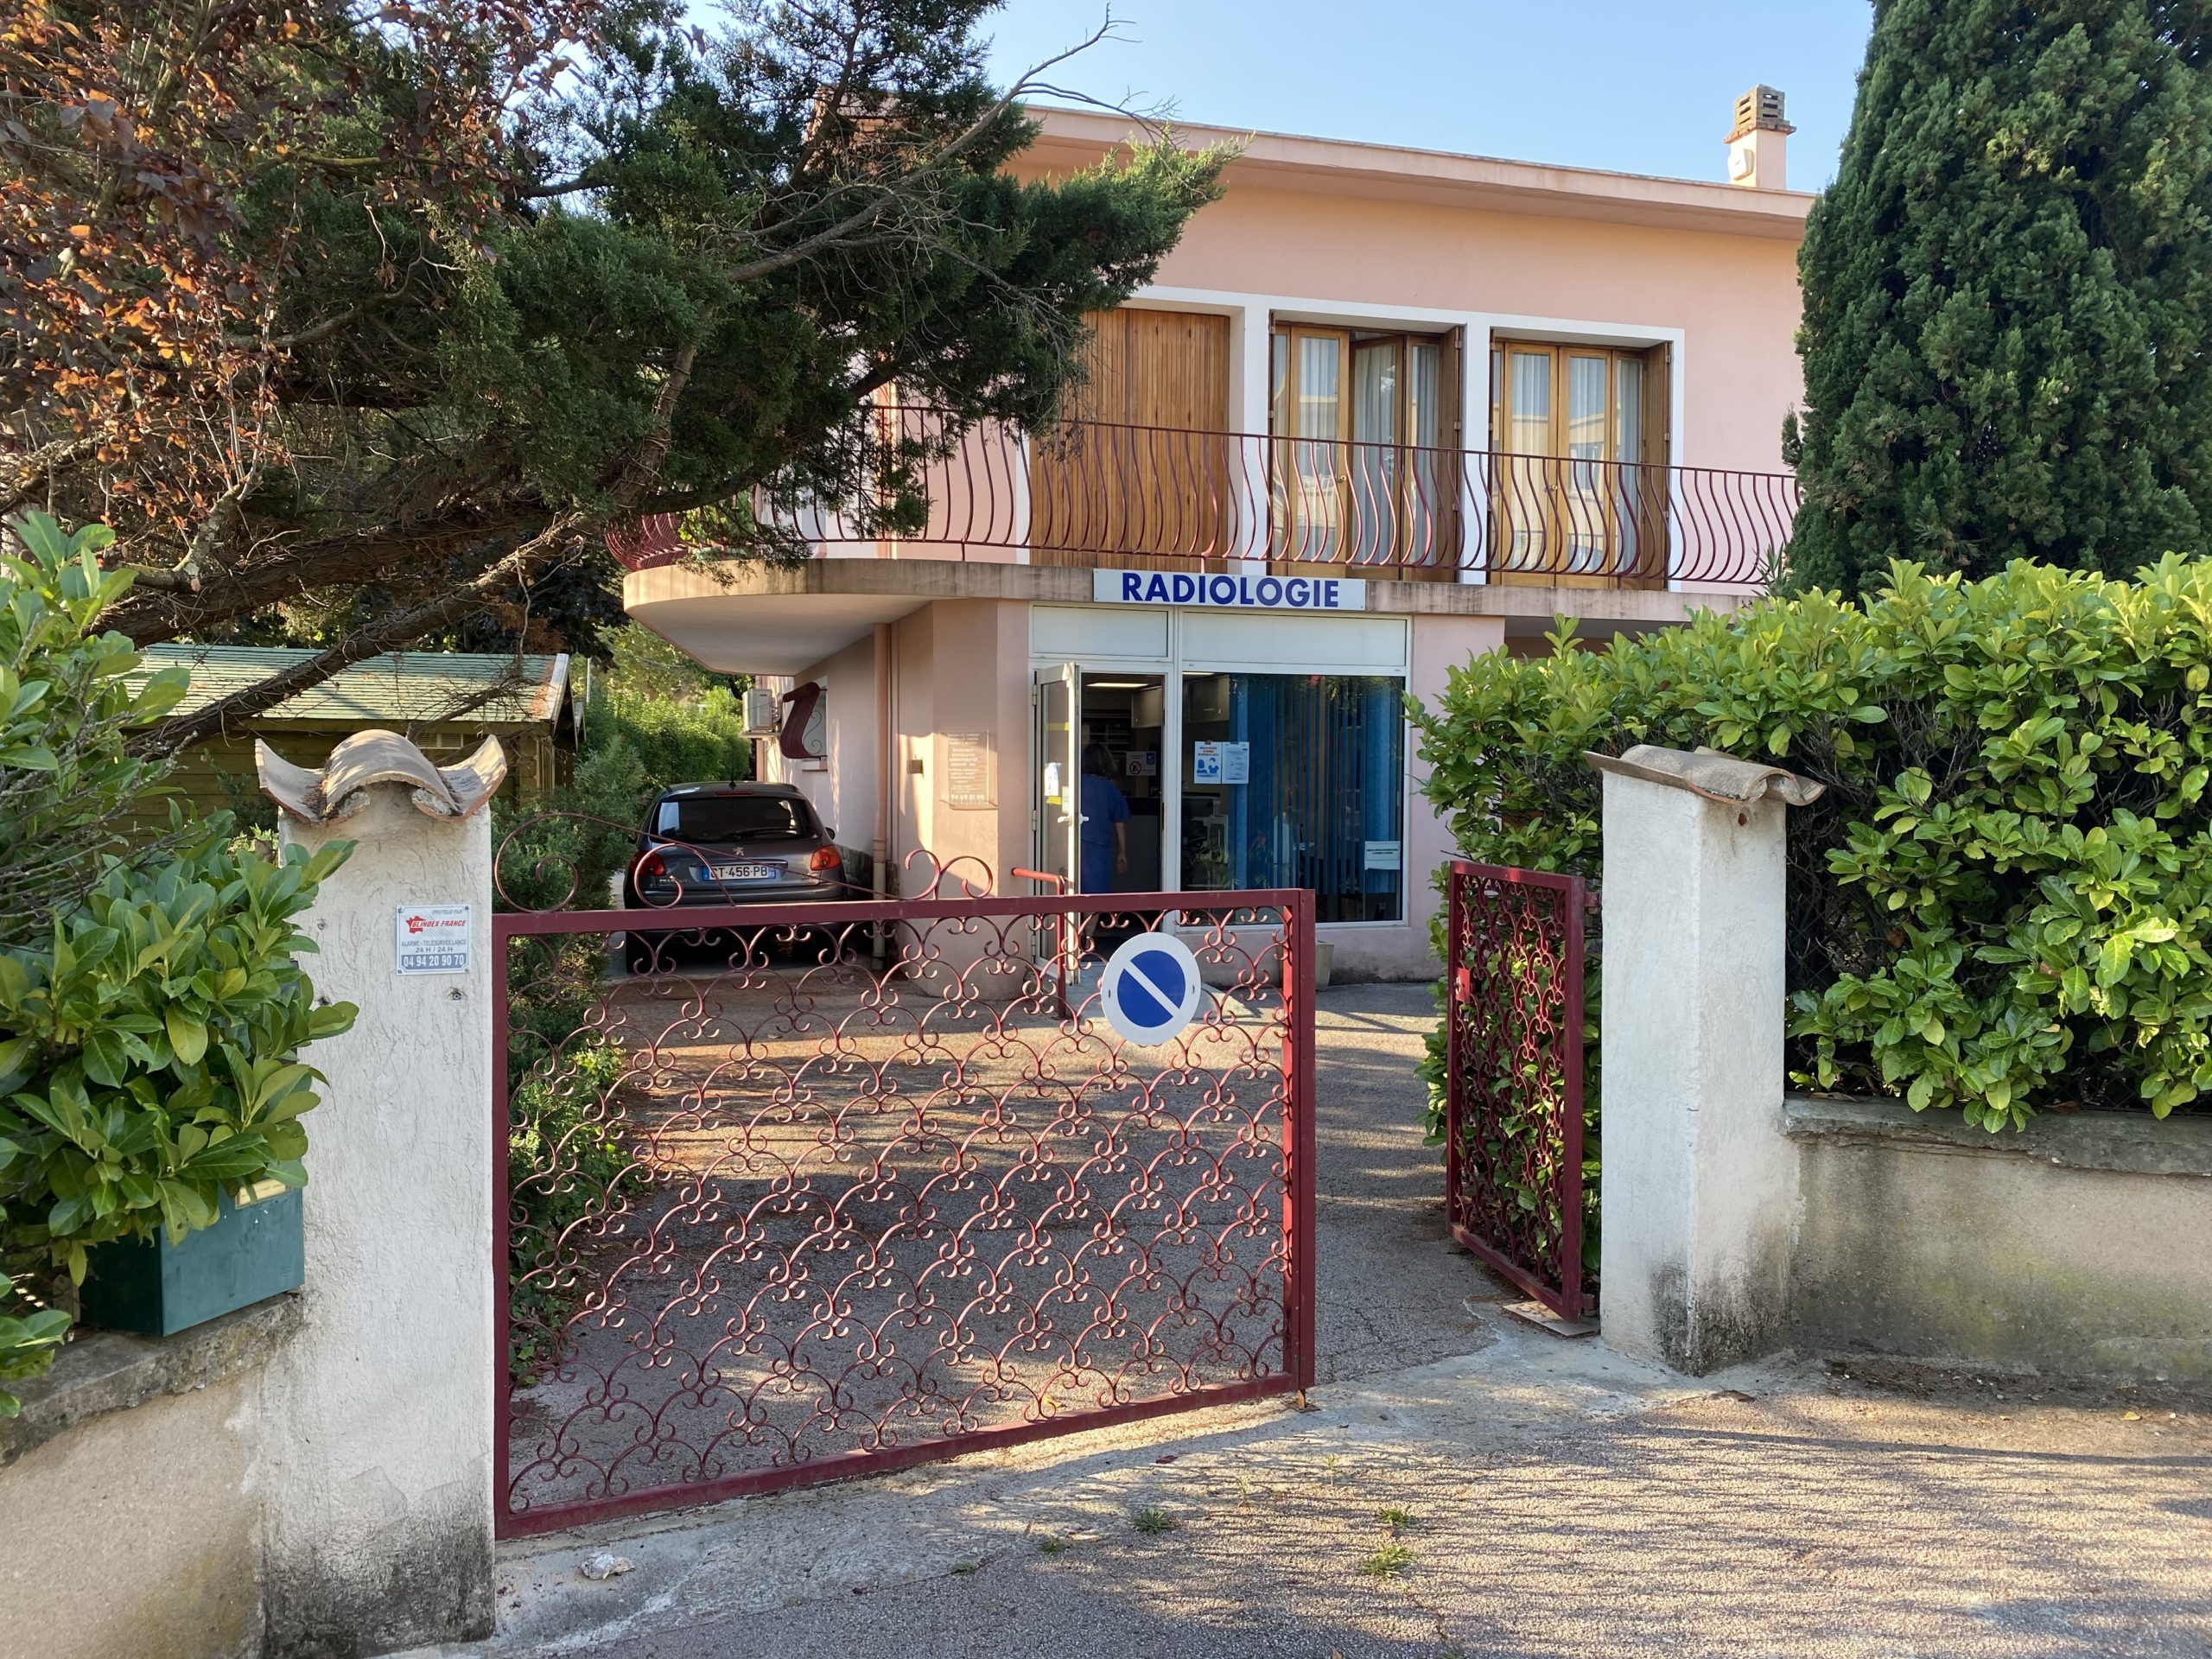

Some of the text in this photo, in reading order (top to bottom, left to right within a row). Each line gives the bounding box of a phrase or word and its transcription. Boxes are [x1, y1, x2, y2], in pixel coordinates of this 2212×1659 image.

[1122, 572, 1339, 607] RADIOLOGIE
[404, 954, 465, 967] 04 94 20 90 70
